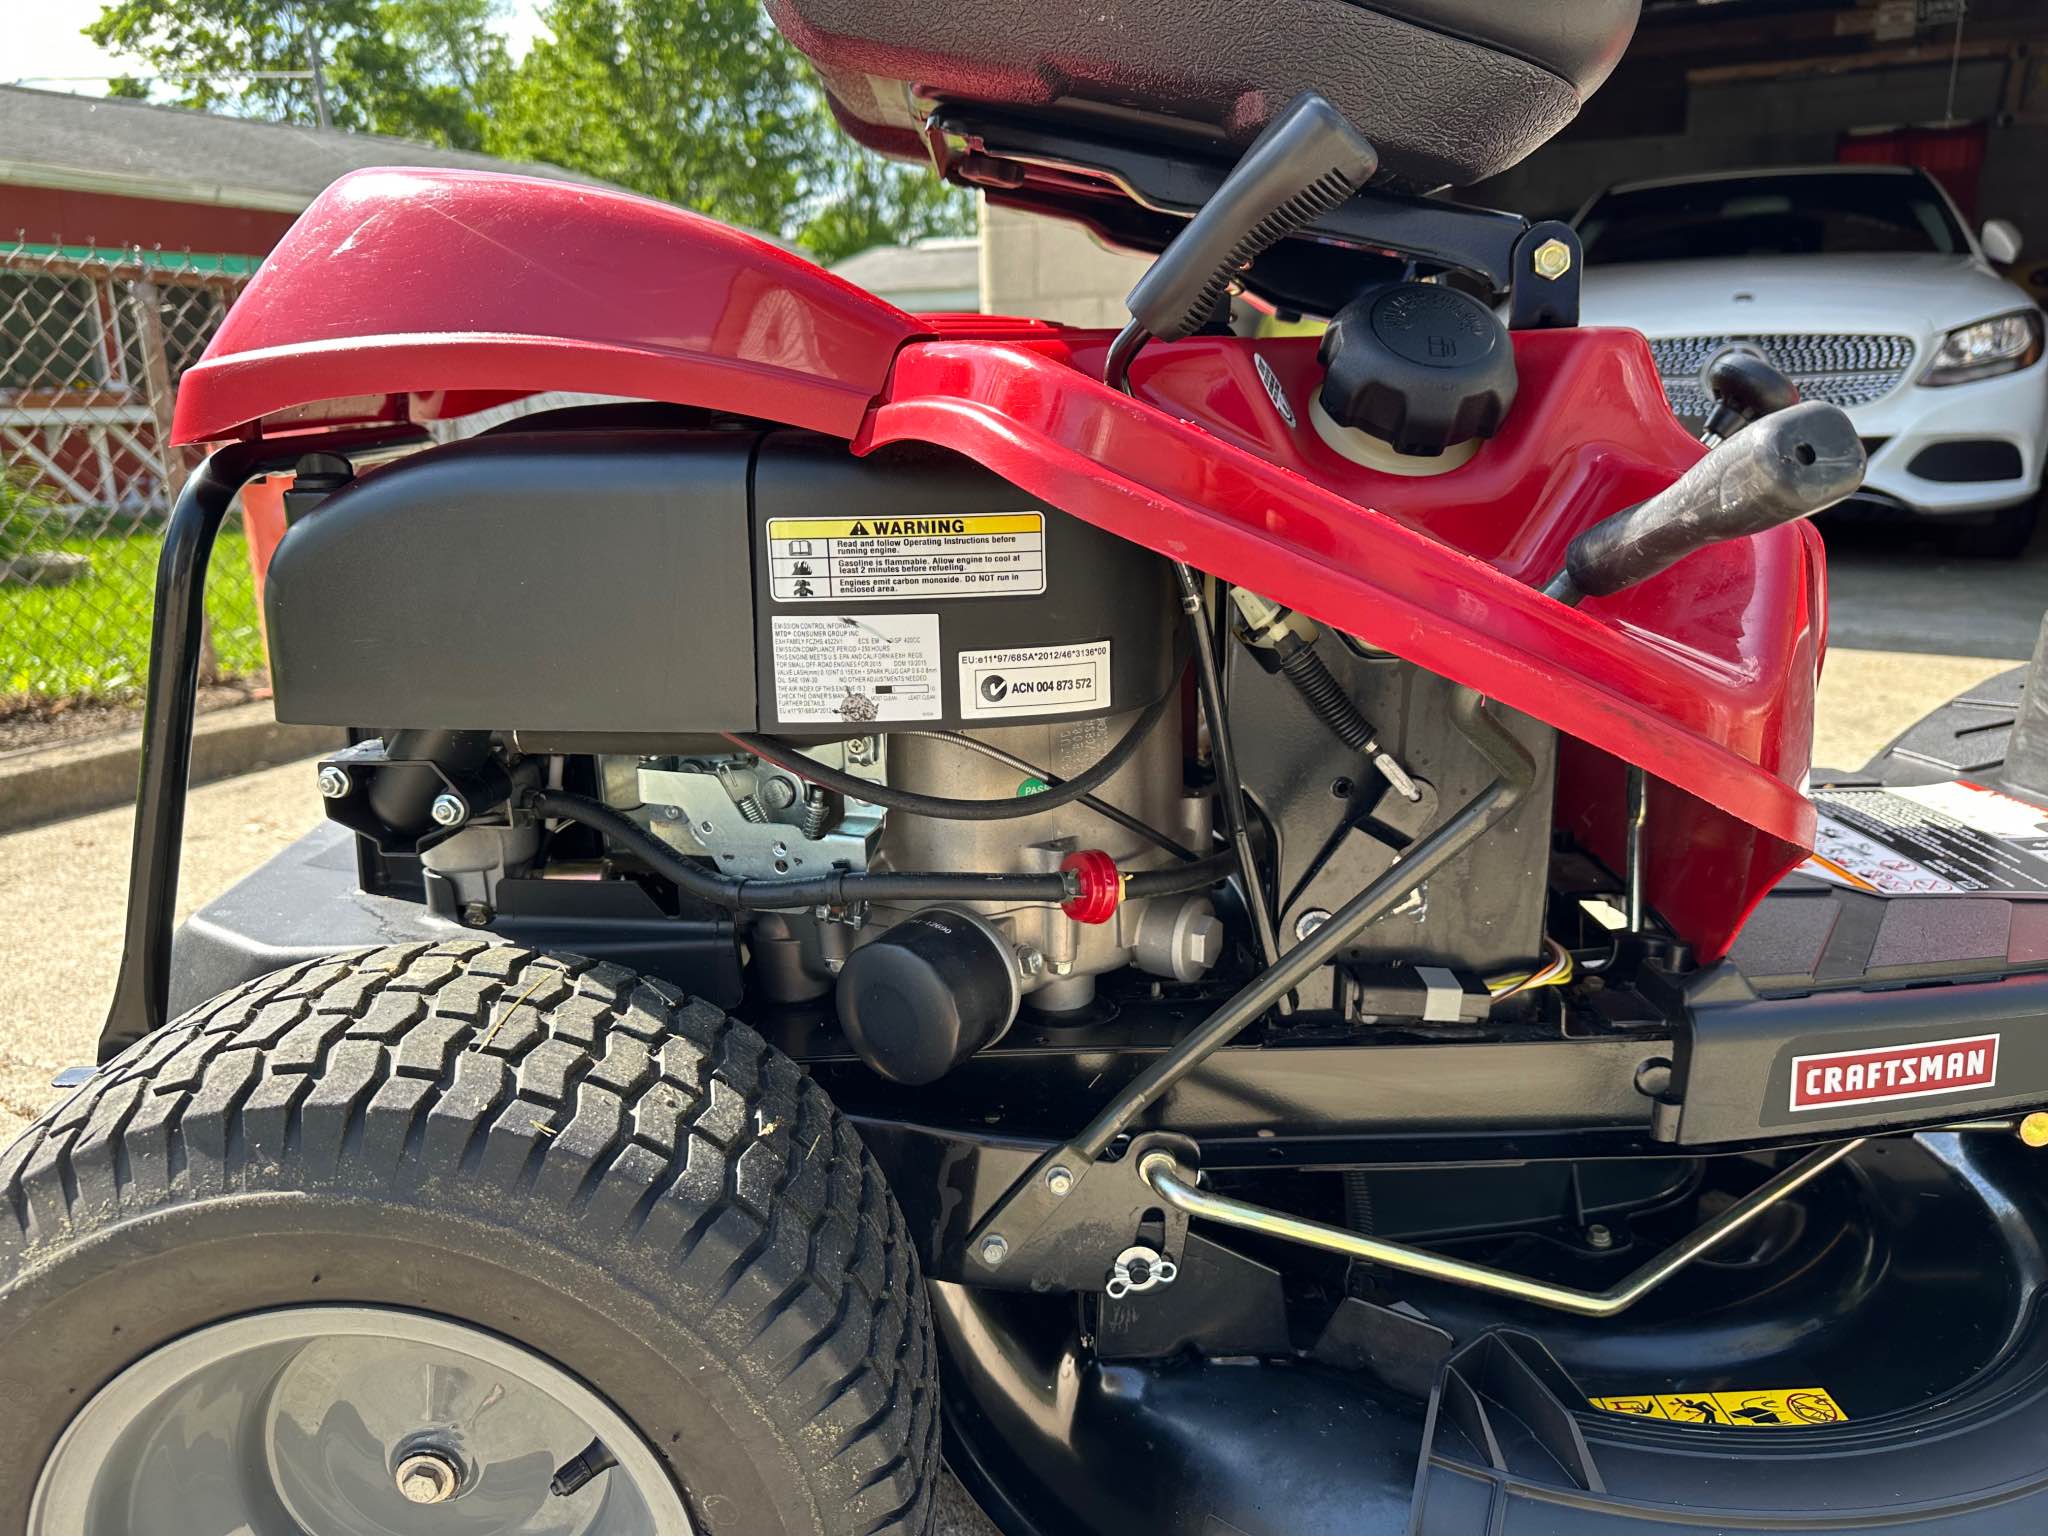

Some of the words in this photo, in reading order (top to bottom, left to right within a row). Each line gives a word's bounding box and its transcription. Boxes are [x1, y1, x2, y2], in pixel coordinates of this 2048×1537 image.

[874, 520, 964, 535] WARNING
[837, 540, 857, 548] Read
[904, 538, 941, 547] Operating
[944, 536, 989, 545] Instructions
[838, 547, 874, 556] running
[877, 547, 899, 555] engine.
[839, 559, 873, 567] Gasoline
[885, 558, 929, 566] flammable.
[932, 556, 954, 564] Allow
[956, 557, 981, 565] engine
[840, 566, 858, 574] least
[868, 565, 900, 573] minutes
[902, 564, 927, 572] before
[929, 563, 966, 573] refueling.
[840, 578, 871, 587] Engines
[922, 576, 962, 584] monoxide.
[979, 574, 994, 582] NOT
[840, 585, 878, 593] enclosed
[1012, 682, 1034, 694] ACN
[1037, 681, 1054, 692] 004
[1056, 680, 1073, 691] 873
[1076, 678, 1092, 689] 572
[1805, 1049, 1985, 1096] CRAFTSMAN
